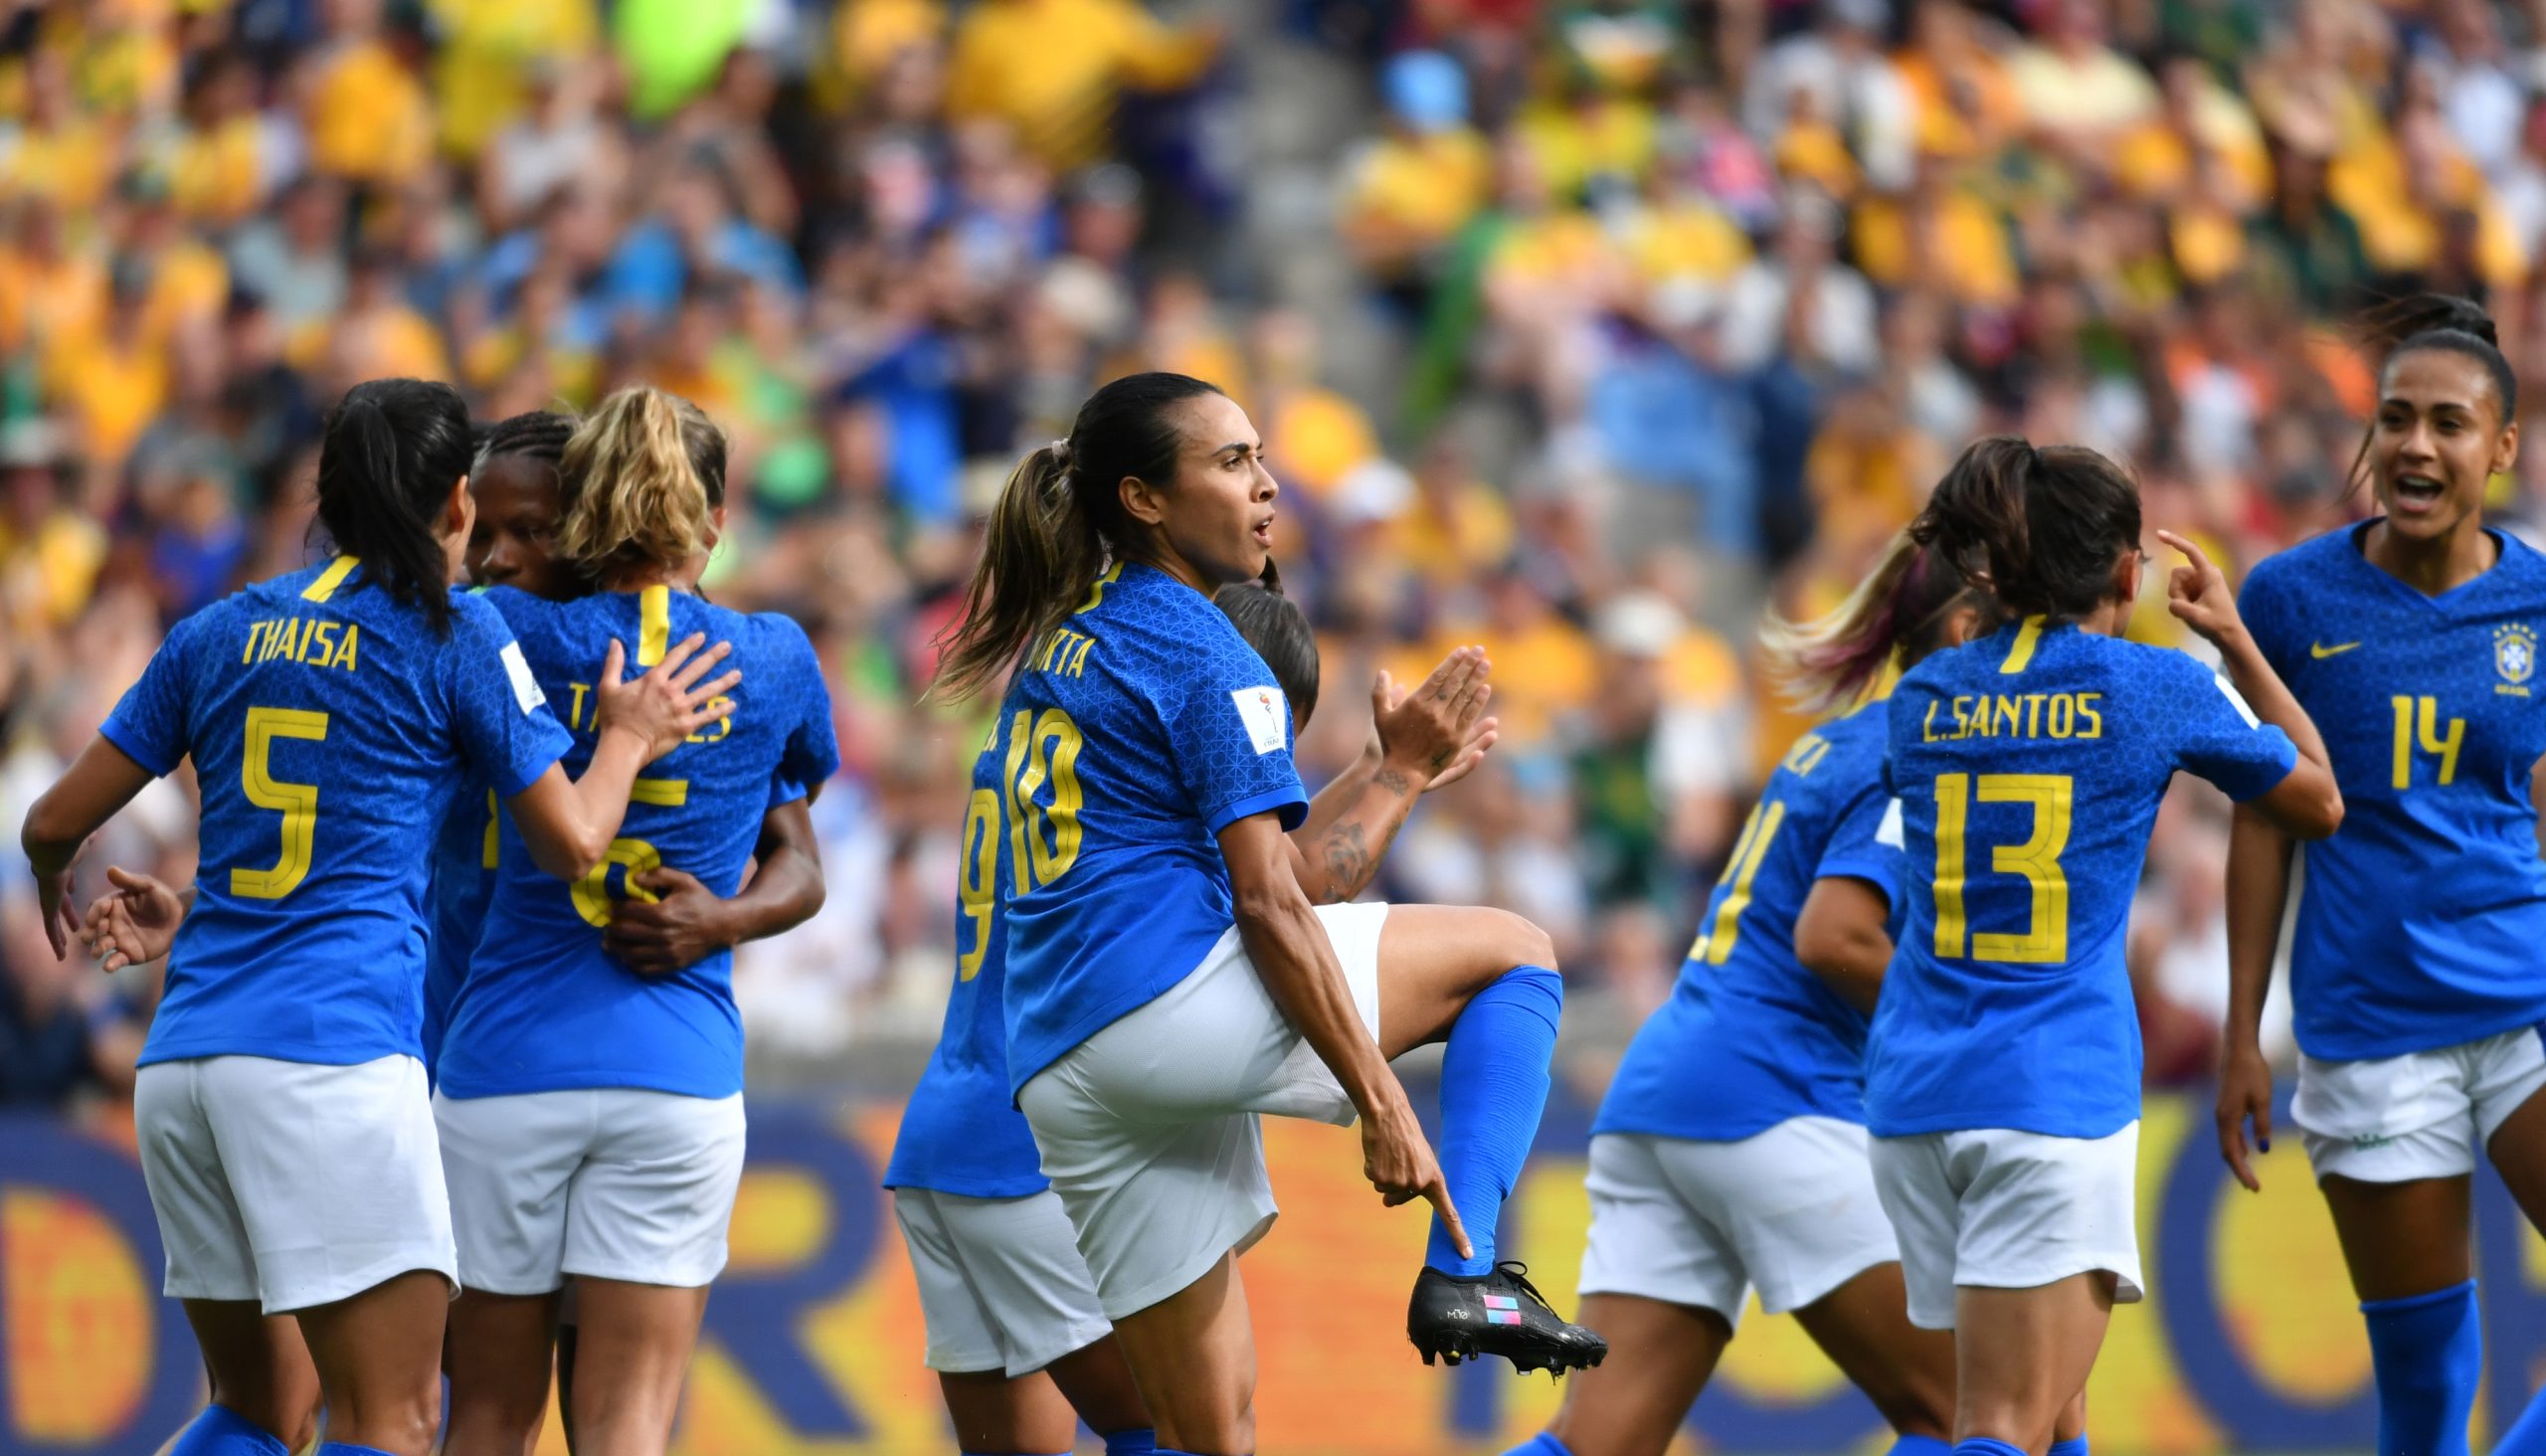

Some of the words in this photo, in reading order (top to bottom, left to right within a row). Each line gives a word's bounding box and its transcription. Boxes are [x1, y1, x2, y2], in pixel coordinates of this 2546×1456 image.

[243, 621, 358, 671] THAISA
[1923, 692, 2102, 743] L.SANTOS
[230, 707, 329, 899] 5
[1004, 708, 1083, 897] 10
[2392, 695, 2465, 790] 14
[959, 789, 1000, 983] 9
[1933, 773, 2073, 963] 13
